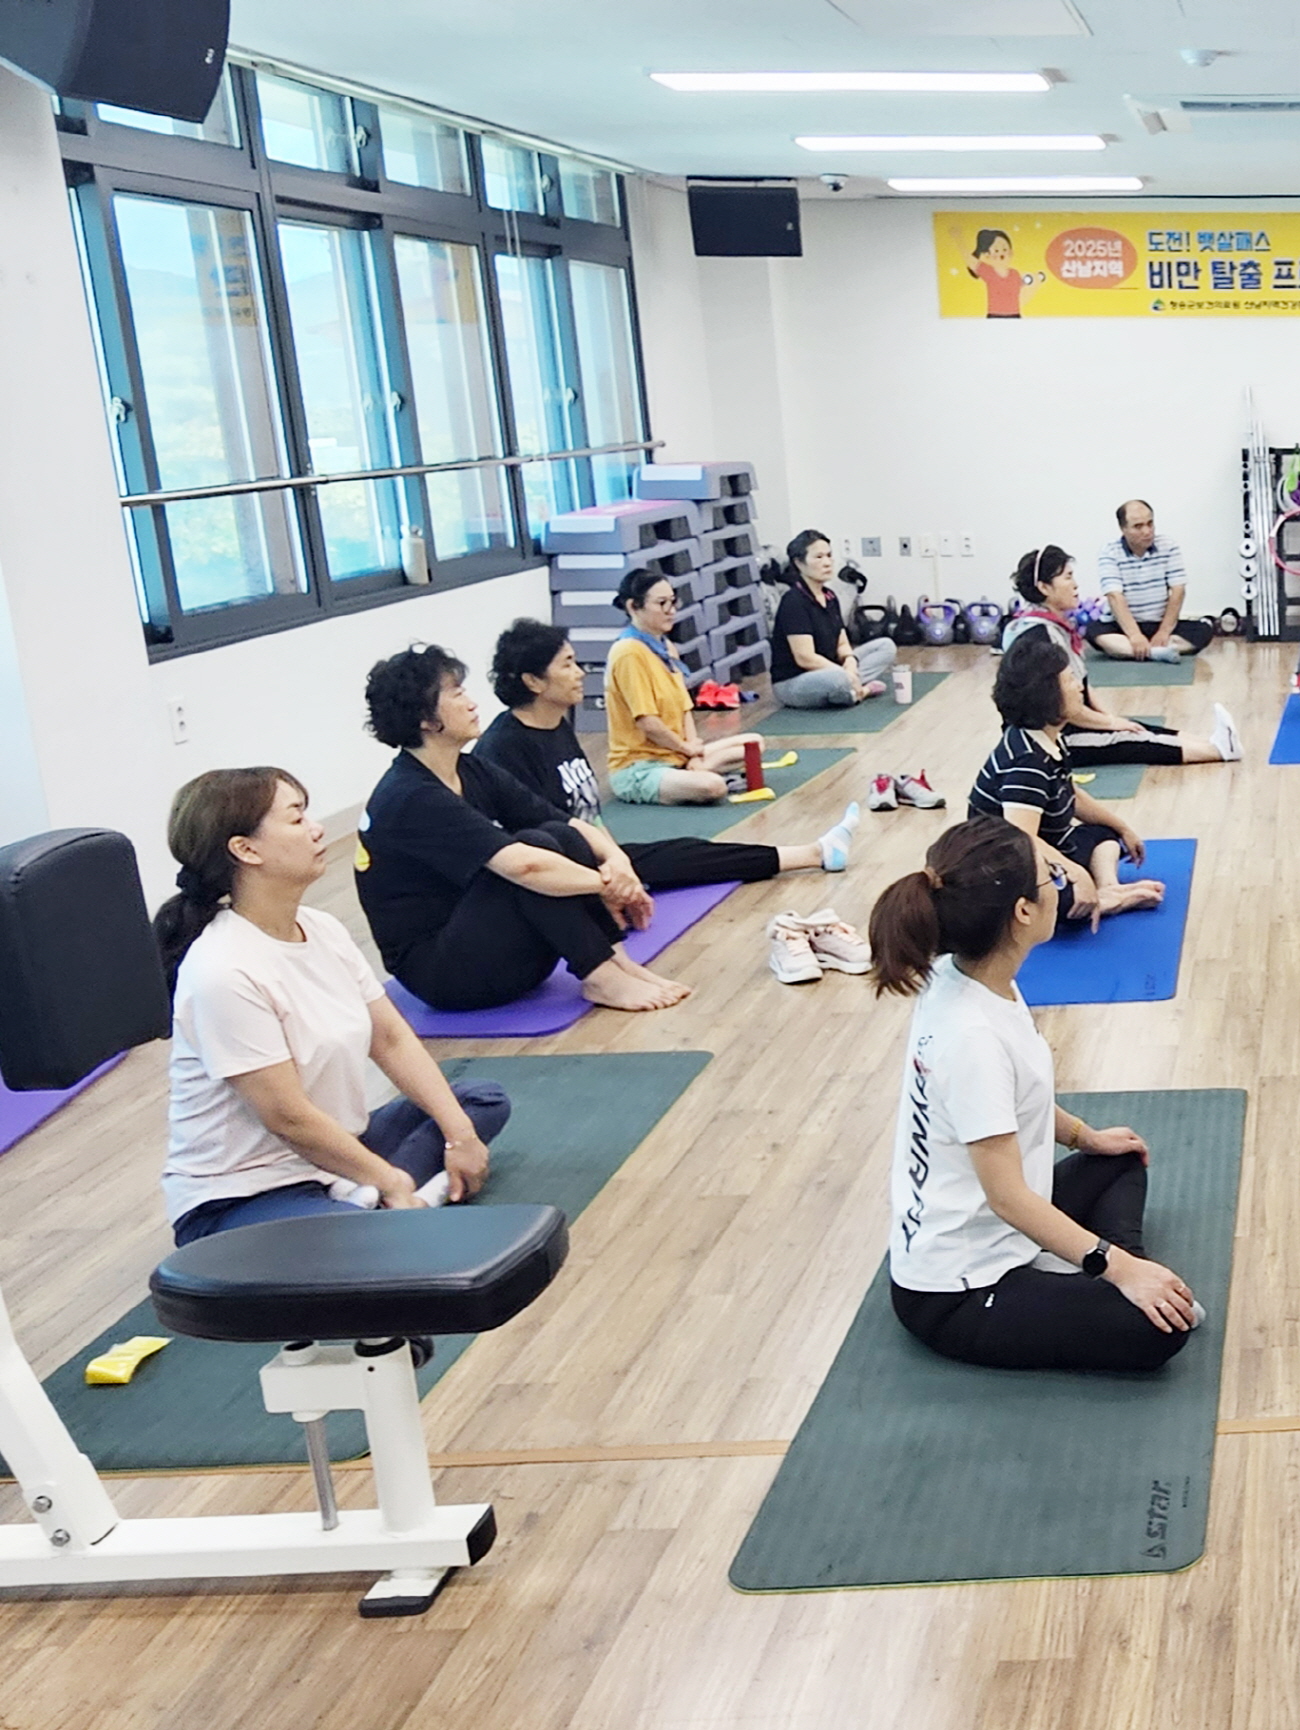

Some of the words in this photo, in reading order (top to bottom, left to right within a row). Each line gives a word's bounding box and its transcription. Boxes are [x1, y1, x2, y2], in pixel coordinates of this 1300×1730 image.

[1063, 239, 1123, 258] 2025년
[1148, 231, 1190, 252] 도전!
[1197, 231, 1271, 252] 뱃살패스
[1061, 260, 1124, 278] 산남지역
[1149, 260, 1201, 290] 비만
[1211, 260, 1262, 290] 탈출
